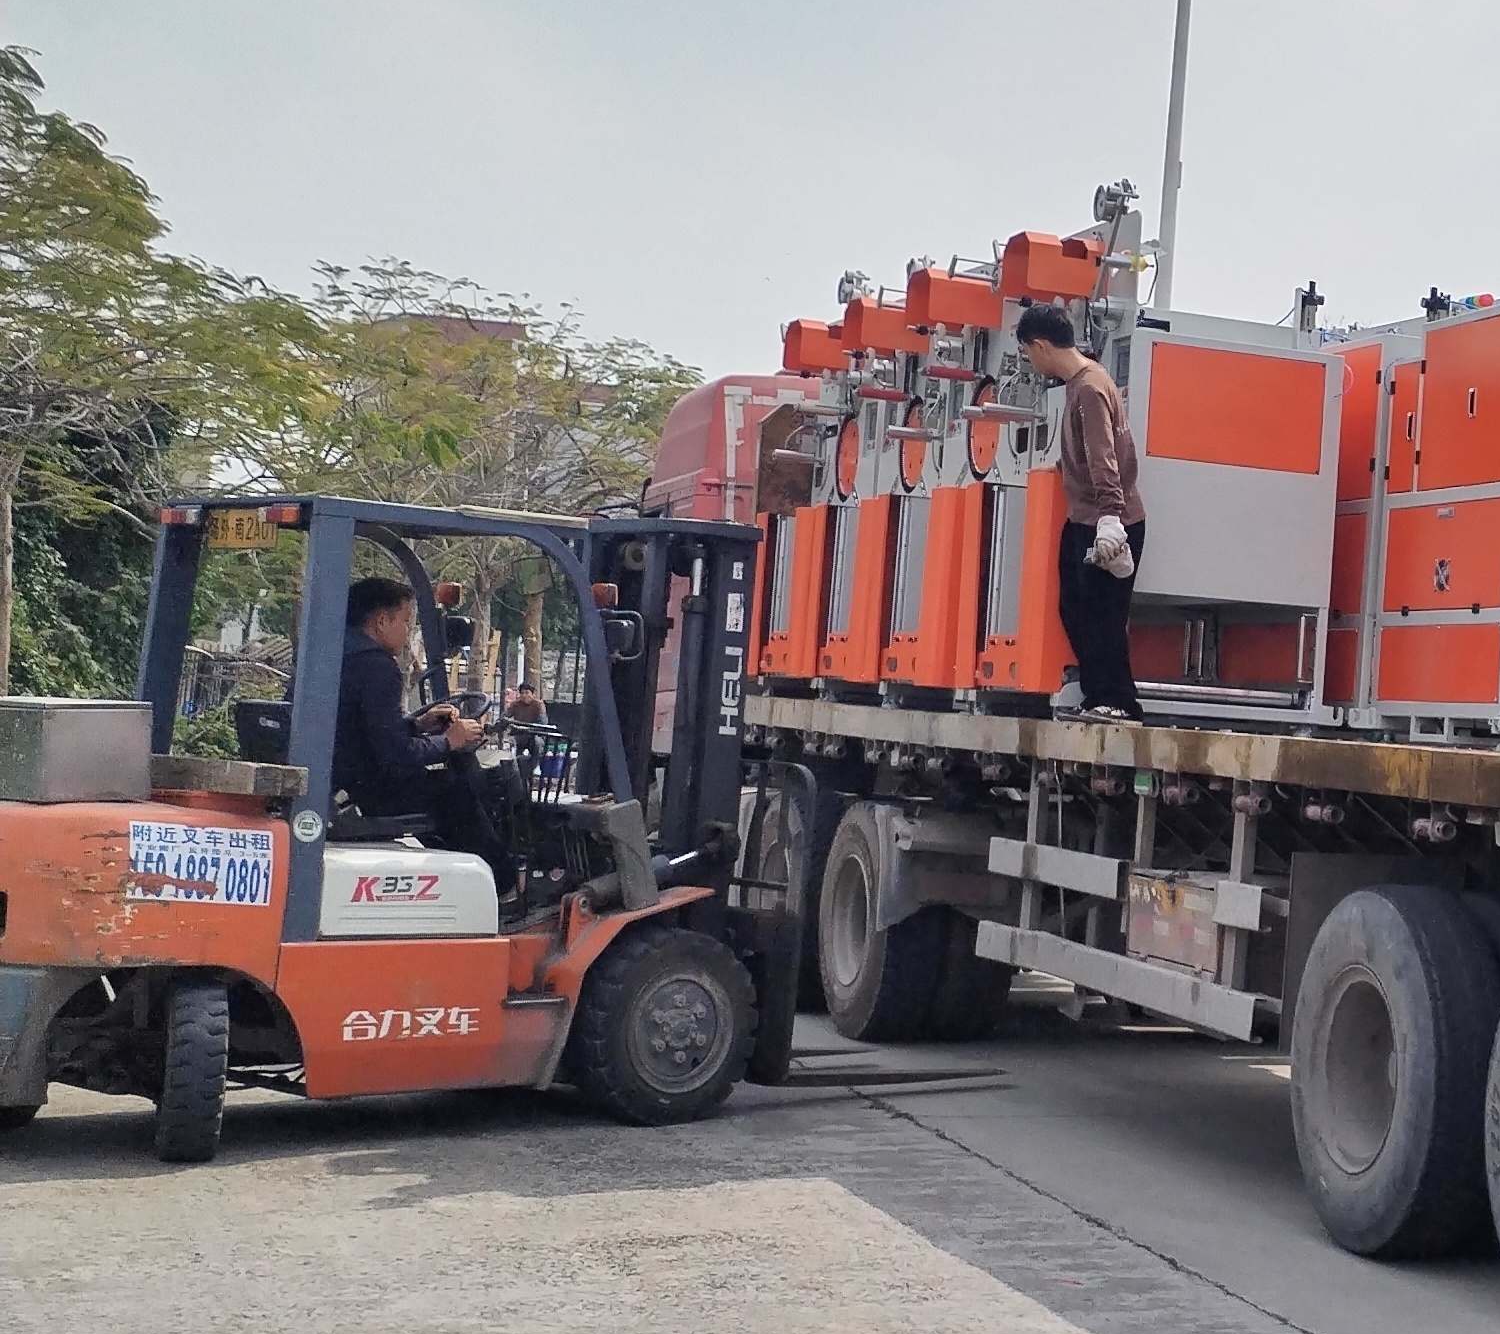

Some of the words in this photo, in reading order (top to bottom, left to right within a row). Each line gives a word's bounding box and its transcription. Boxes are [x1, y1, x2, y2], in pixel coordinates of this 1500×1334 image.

[719, 646, 743, 735] HELI
[132, 824, 271, 851] 附近叉车出租
[225, 857, 271, 904] 0801
[341, 1007, 480, 1041] 合力叉车
